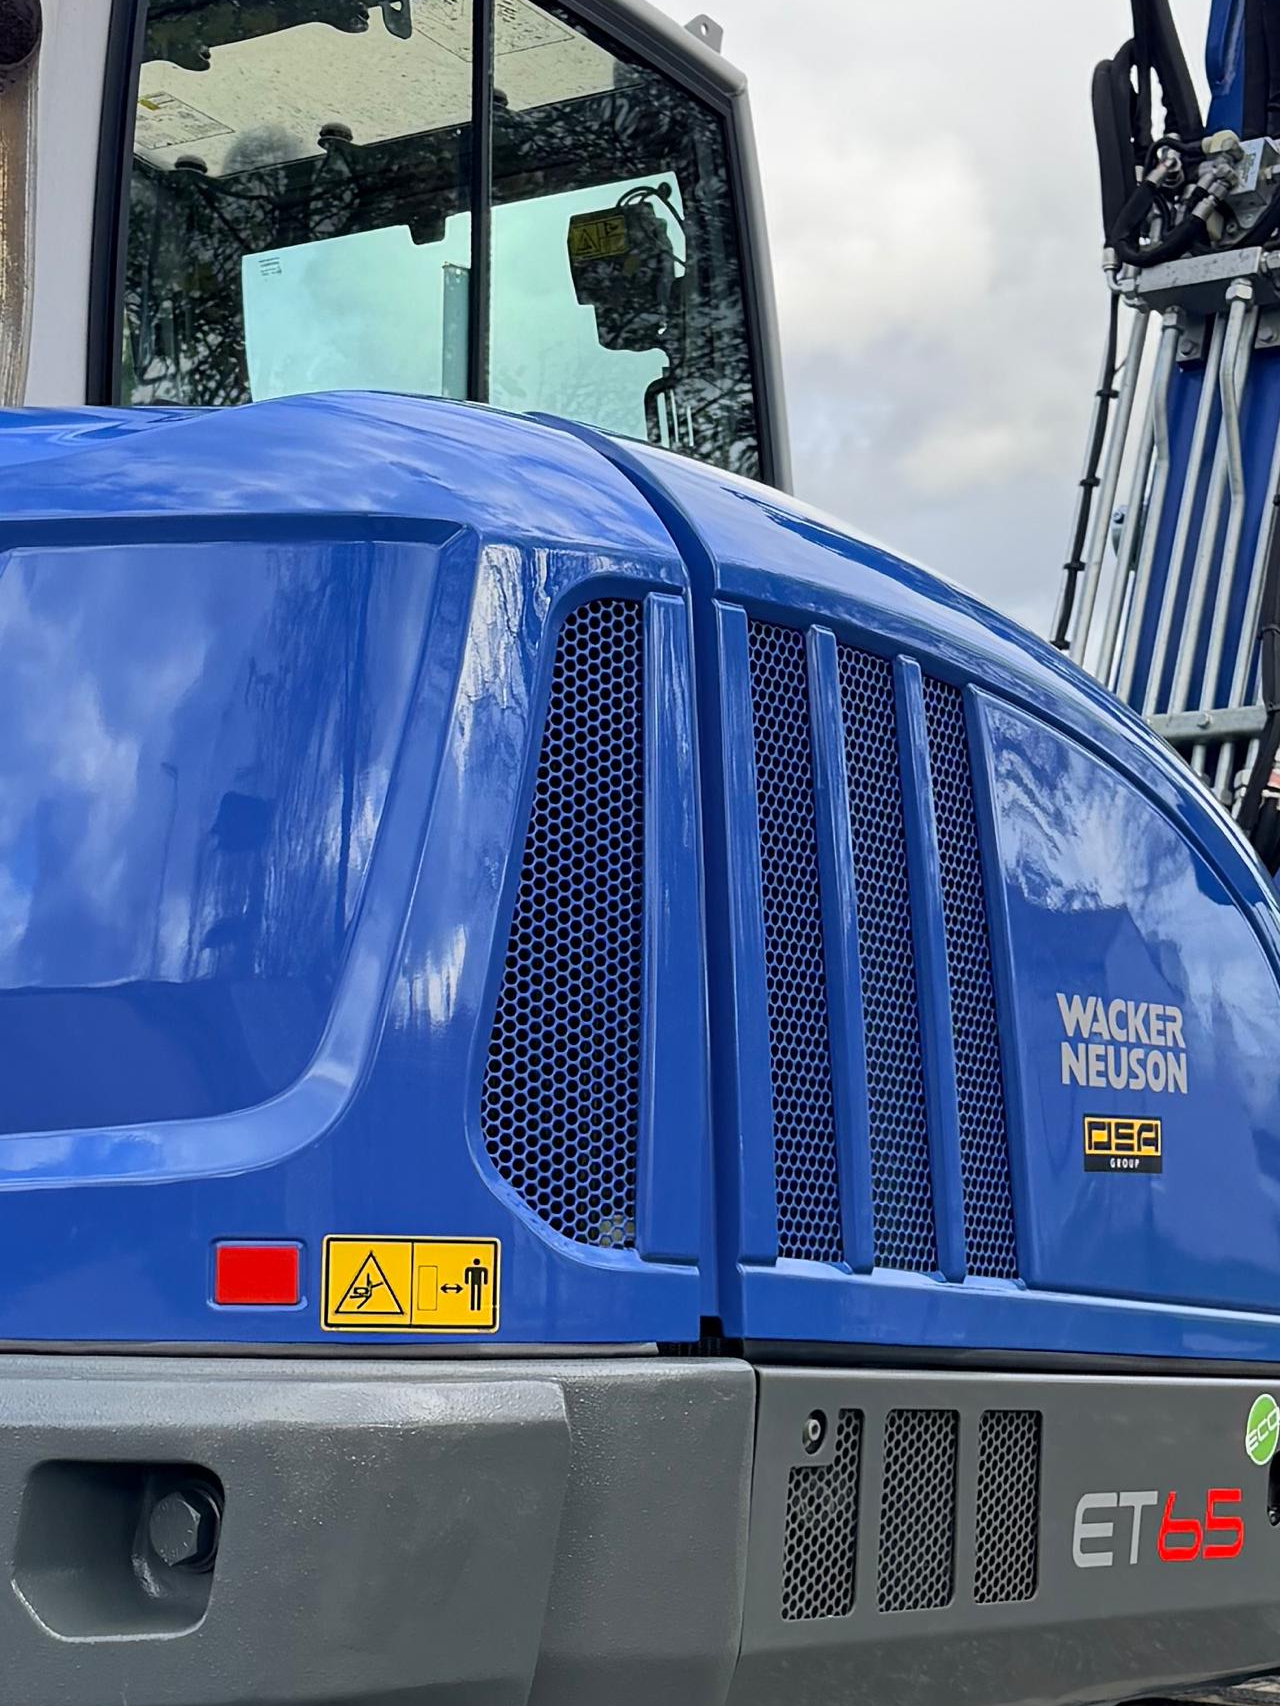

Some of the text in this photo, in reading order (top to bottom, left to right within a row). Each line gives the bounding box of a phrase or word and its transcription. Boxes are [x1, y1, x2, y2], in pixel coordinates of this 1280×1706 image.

[1056, 992, 1187, 1049] WACKER
[1061, 1041, 1189, 1095] NEUSON
[1109, 1157, 1141, 1169] GROUP
[1072, 1487, 1245, 1569] ET65
